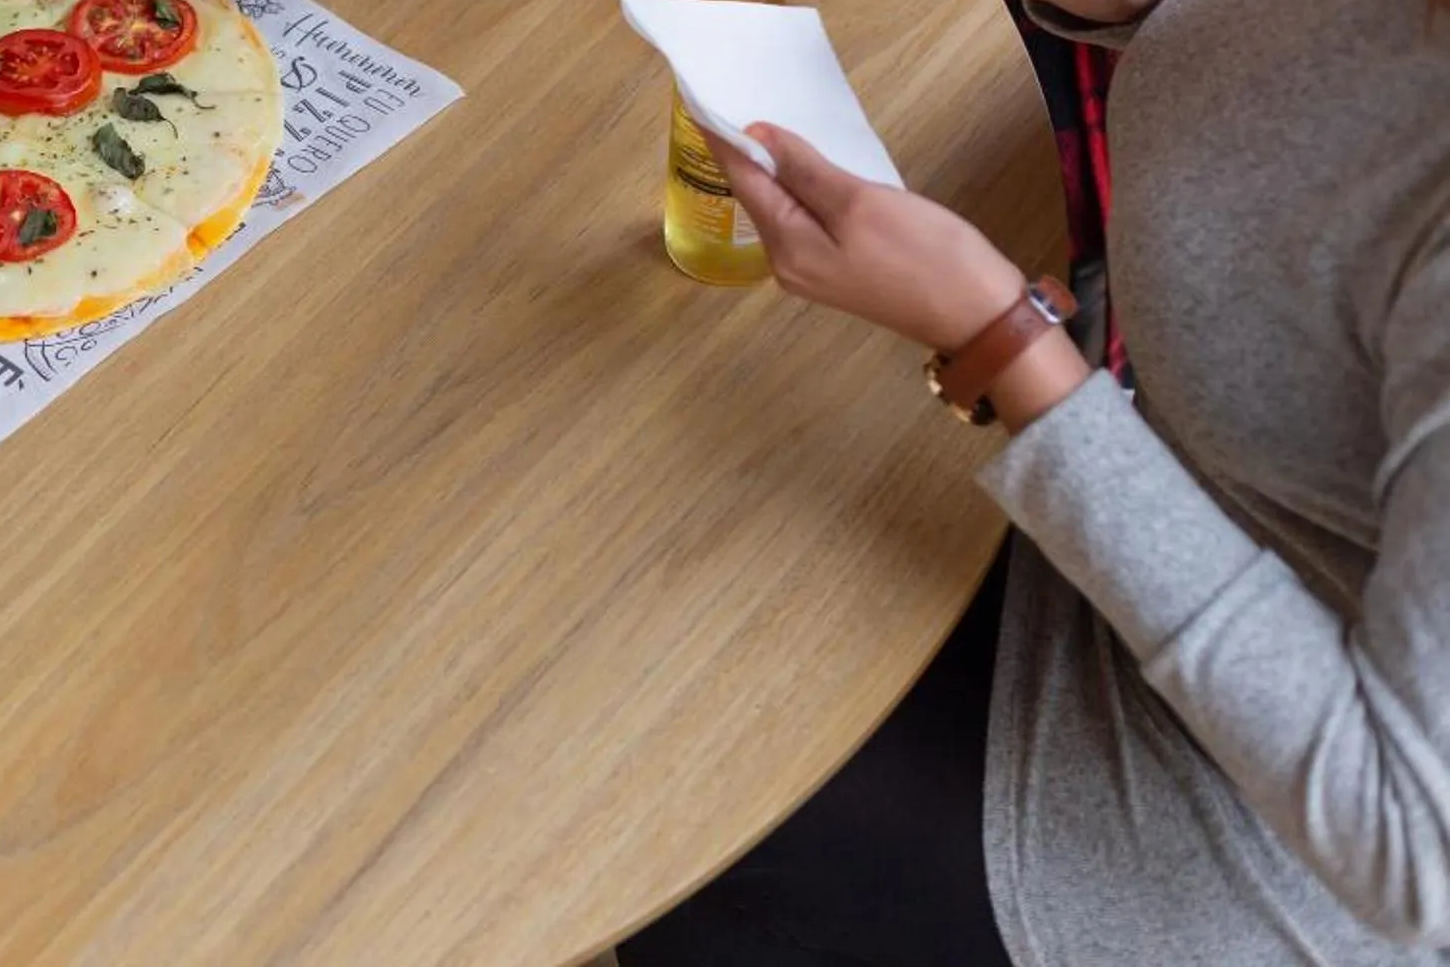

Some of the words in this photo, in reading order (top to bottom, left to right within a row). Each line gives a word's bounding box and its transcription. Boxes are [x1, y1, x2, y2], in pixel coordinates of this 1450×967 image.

[283, 70, 371, 143] PIZZ
[363, 87, 405, 116] EU
[287, 114, 371, 174] QUERO
